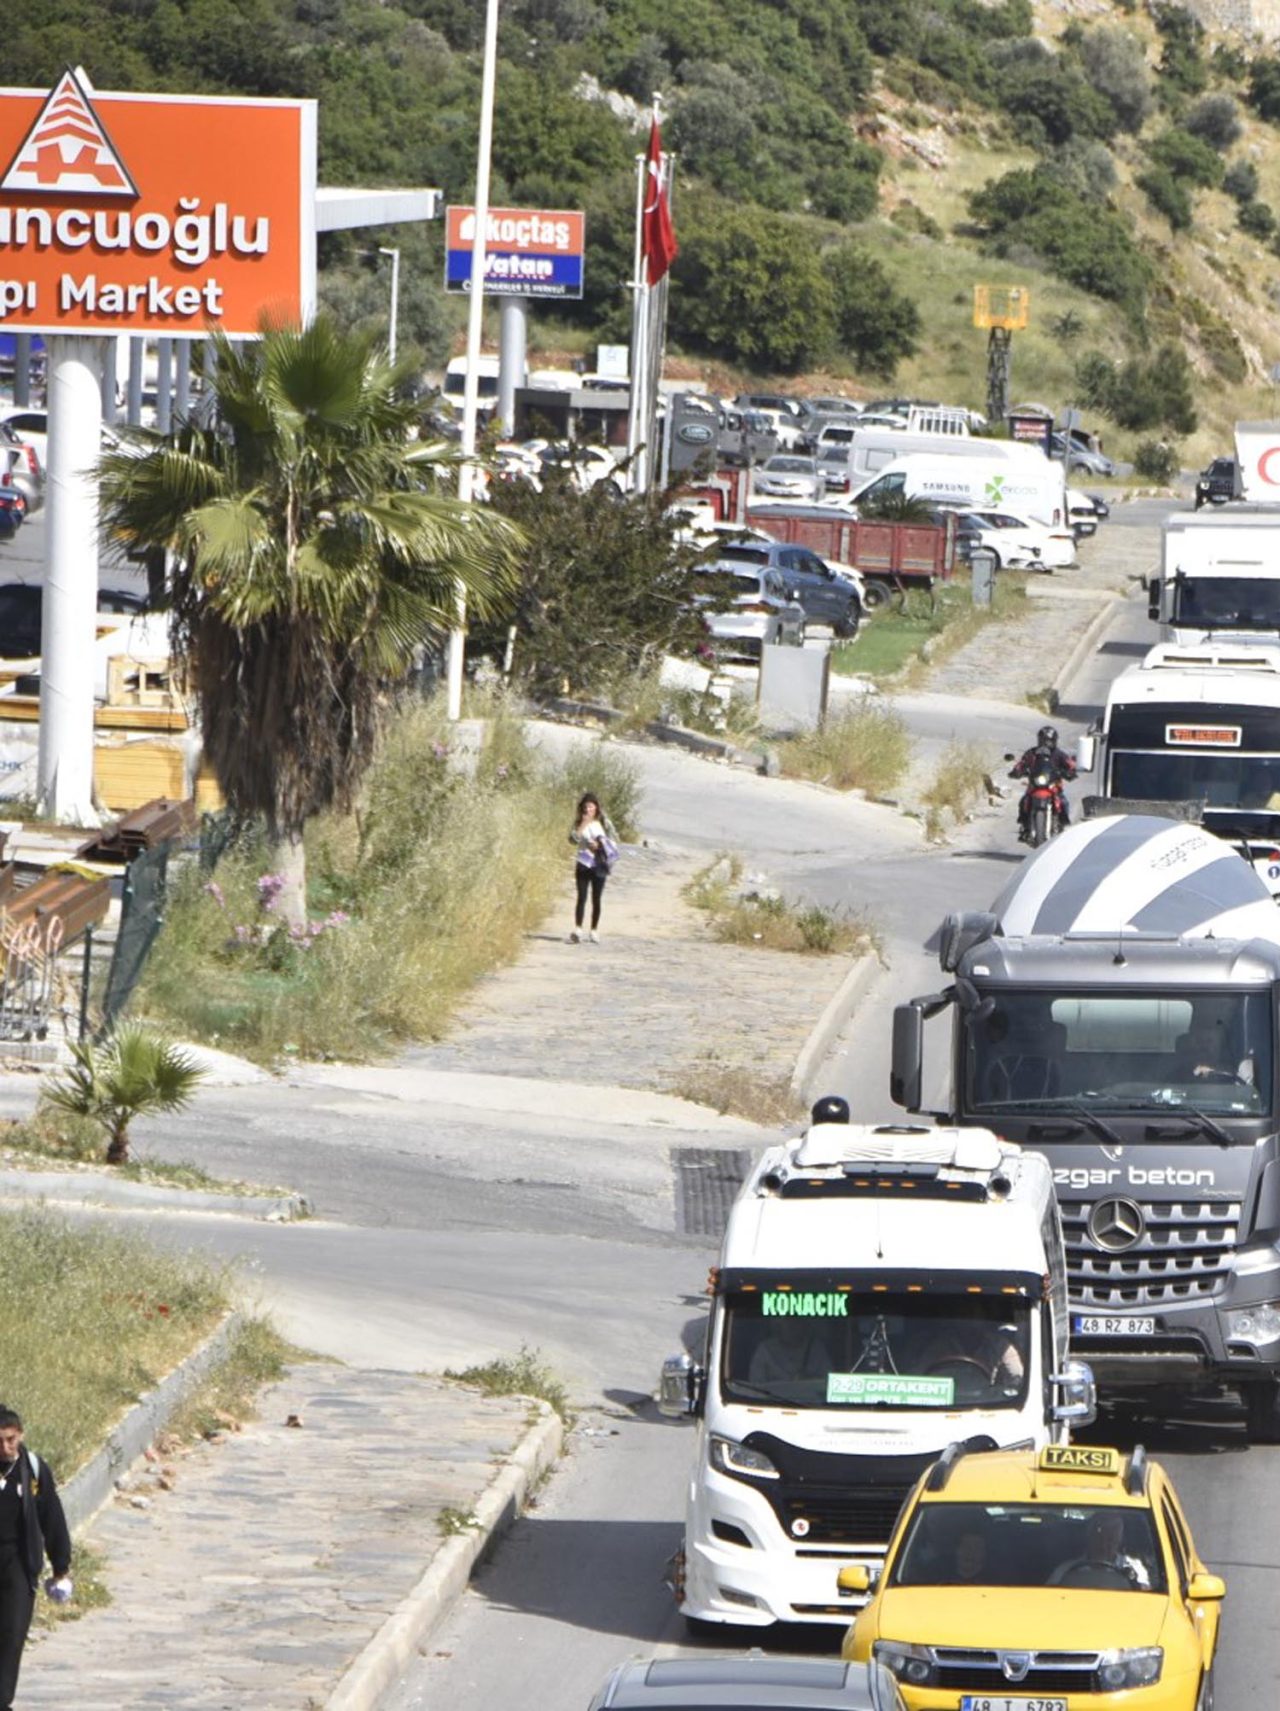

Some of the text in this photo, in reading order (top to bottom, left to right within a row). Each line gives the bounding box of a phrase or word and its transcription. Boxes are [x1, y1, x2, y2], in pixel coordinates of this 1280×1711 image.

[0, 197, 269, 265] ncuoğlu
[60, 273, 223, 315] Market
[1053, 1165, 1215, 1189] zgar beton
[762, 1292, 848, 1316] KONACIK
[1082, 1319, 1153, 1333] 48 RZ 873
[867, 1381, 949, 1395] ORTAKENT
[1004, 1700, 1013, 1711] T
